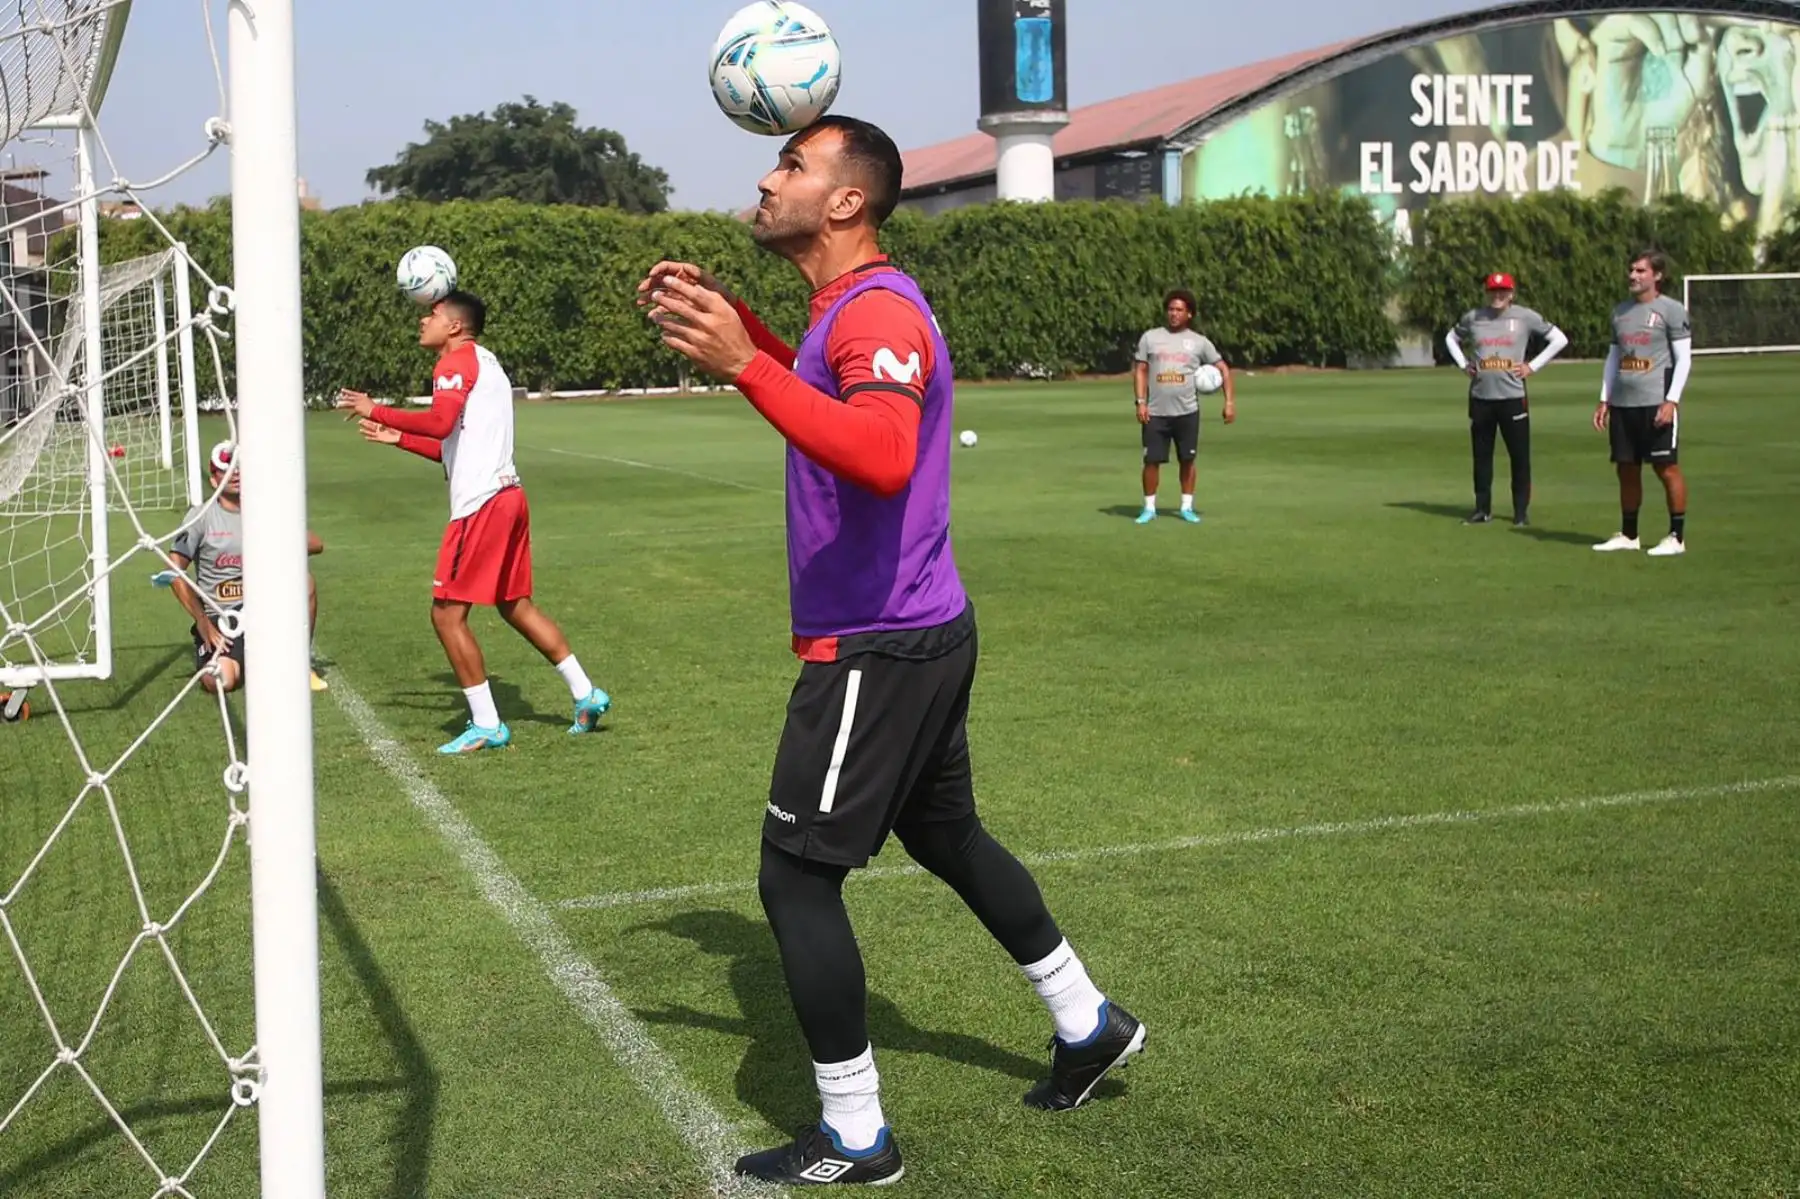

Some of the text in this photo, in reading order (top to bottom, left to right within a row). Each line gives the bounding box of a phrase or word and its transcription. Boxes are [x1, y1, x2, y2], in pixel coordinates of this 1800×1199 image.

[1410, 74, 1533, 127] SIENTE
[1360, 140, 1582, 194] EL SABOR DE
